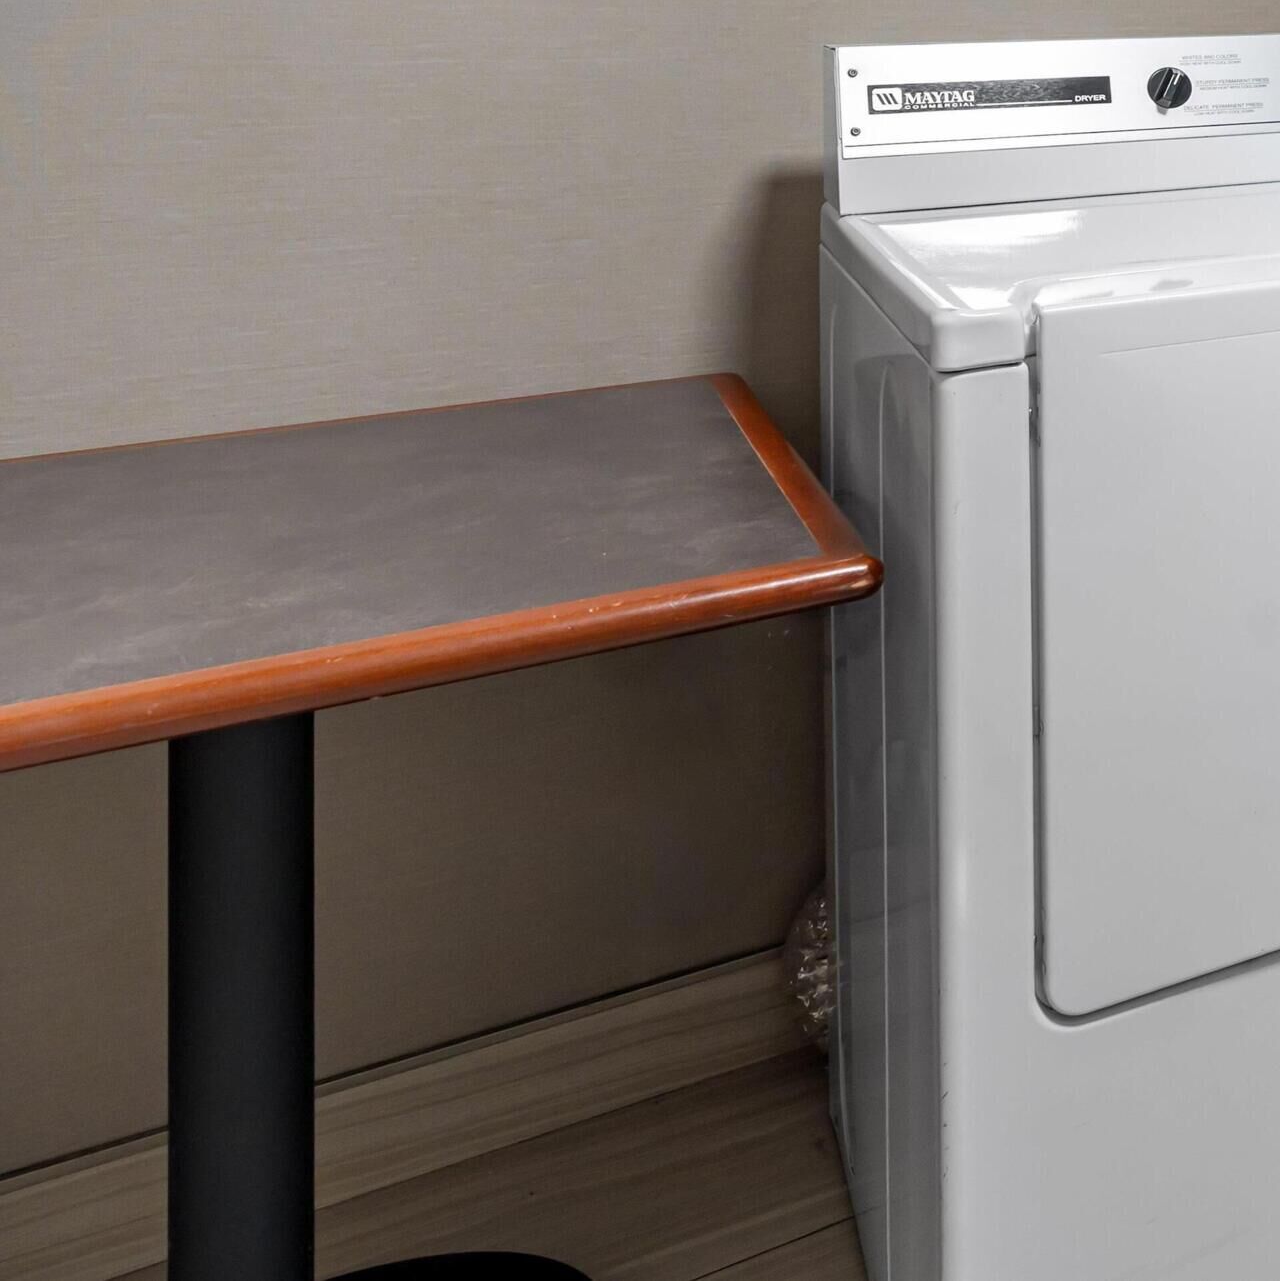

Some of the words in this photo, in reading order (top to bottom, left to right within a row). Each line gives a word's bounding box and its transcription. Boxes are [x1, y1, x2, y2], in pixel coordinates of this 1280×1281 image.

[904, 90, 975, 105] MAYTAG
[1074, 93, 1107, 103] DRYER
[904, 102, 975, 110] COMMERCIAL
